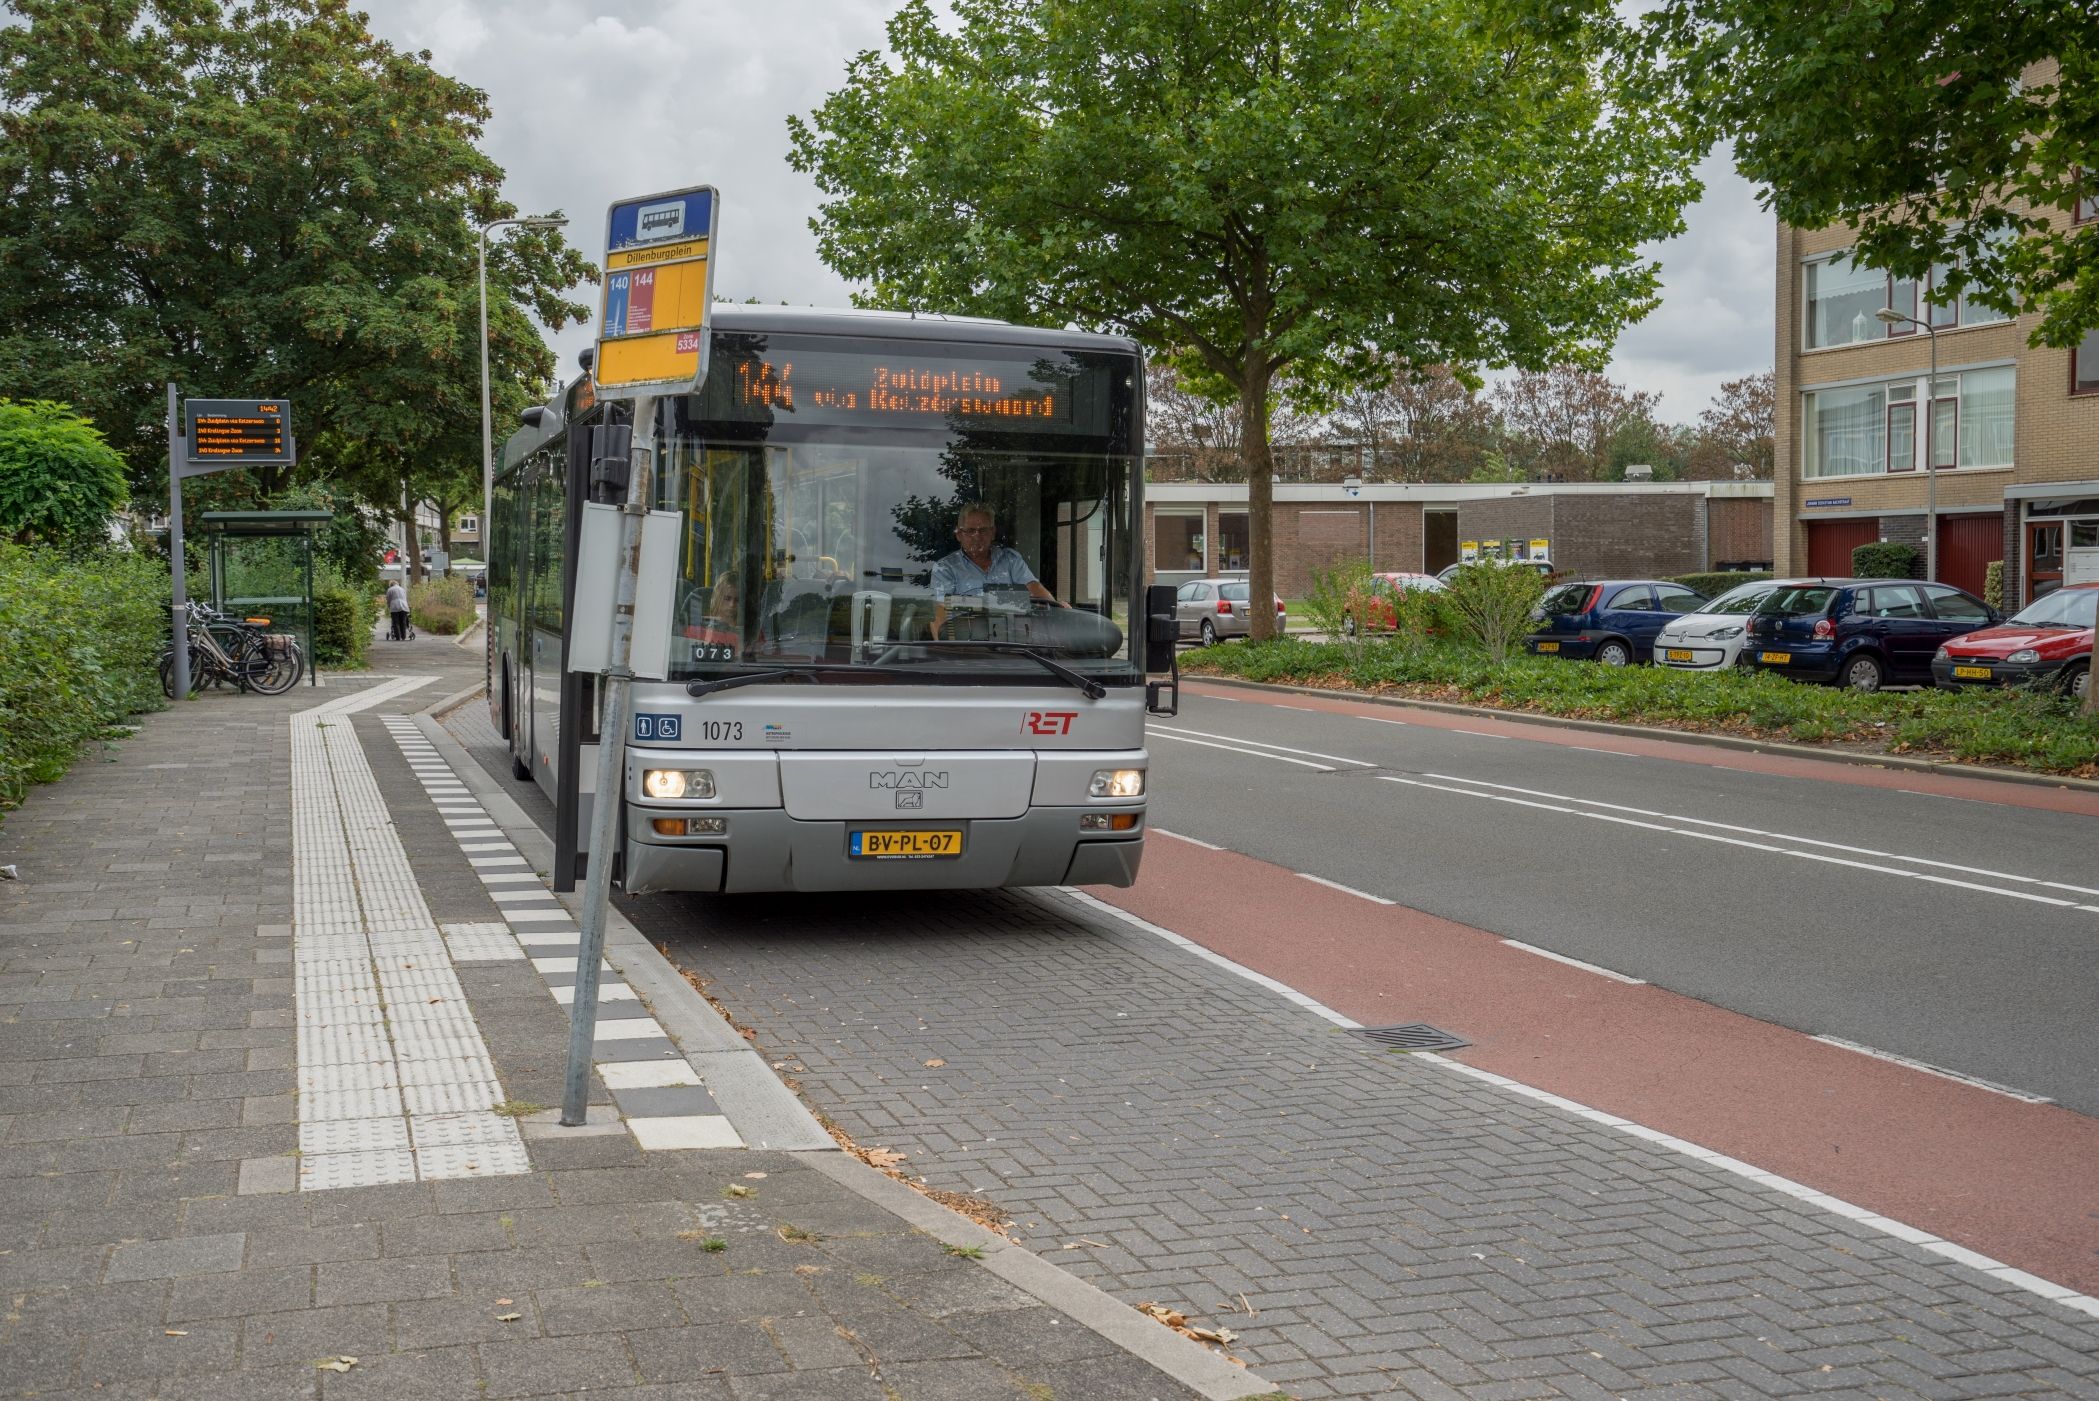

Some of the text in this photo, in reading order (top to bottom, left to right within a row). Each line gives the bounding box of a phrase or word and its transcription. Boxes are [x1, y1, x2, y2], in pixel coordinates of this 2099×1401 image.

[627, 245, 692, 264] Dillenburgplein
[610, 276, 628, 290] 140
[634, 272, 653, 287] 144
[677, 339, 698, 350] 5334
[702, 721, 743, 741] 1073
[1020, 712, 1079, 735] RET
[869, 771, 949, 789] MAN
[868, 834, 953, 851] BV-PL-07
